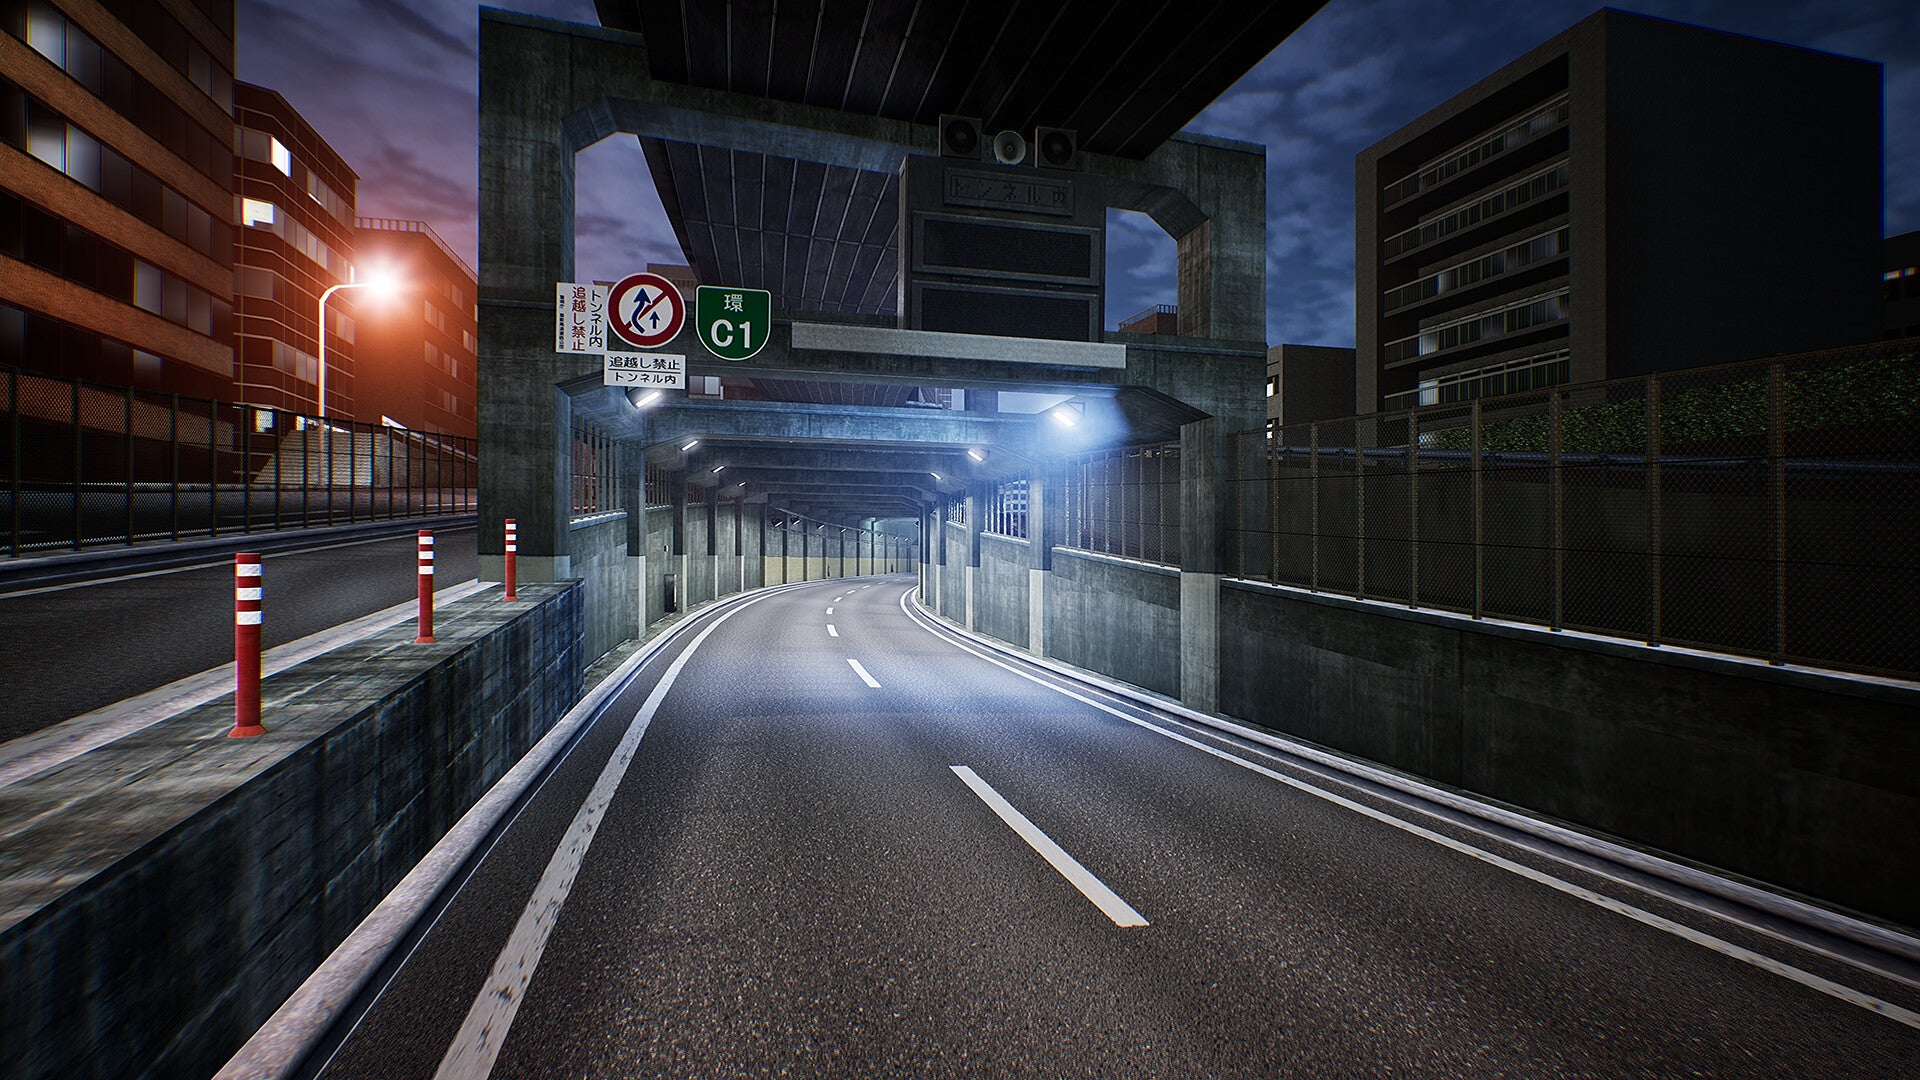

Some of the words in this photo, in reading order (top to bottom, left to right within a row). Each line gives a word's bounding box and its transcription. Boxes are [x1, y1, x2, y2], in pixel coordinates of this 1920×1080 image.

[724, 294, 744, 312] 環
[571, 286, 586, 352] 追越し禁止
[589, 289, 603, 348] トンネル内
[711, 319, 752, 349] C1
[609, 356, 680, 370] 追越し禁止
[615, 372, 677, 385] トンネル内
